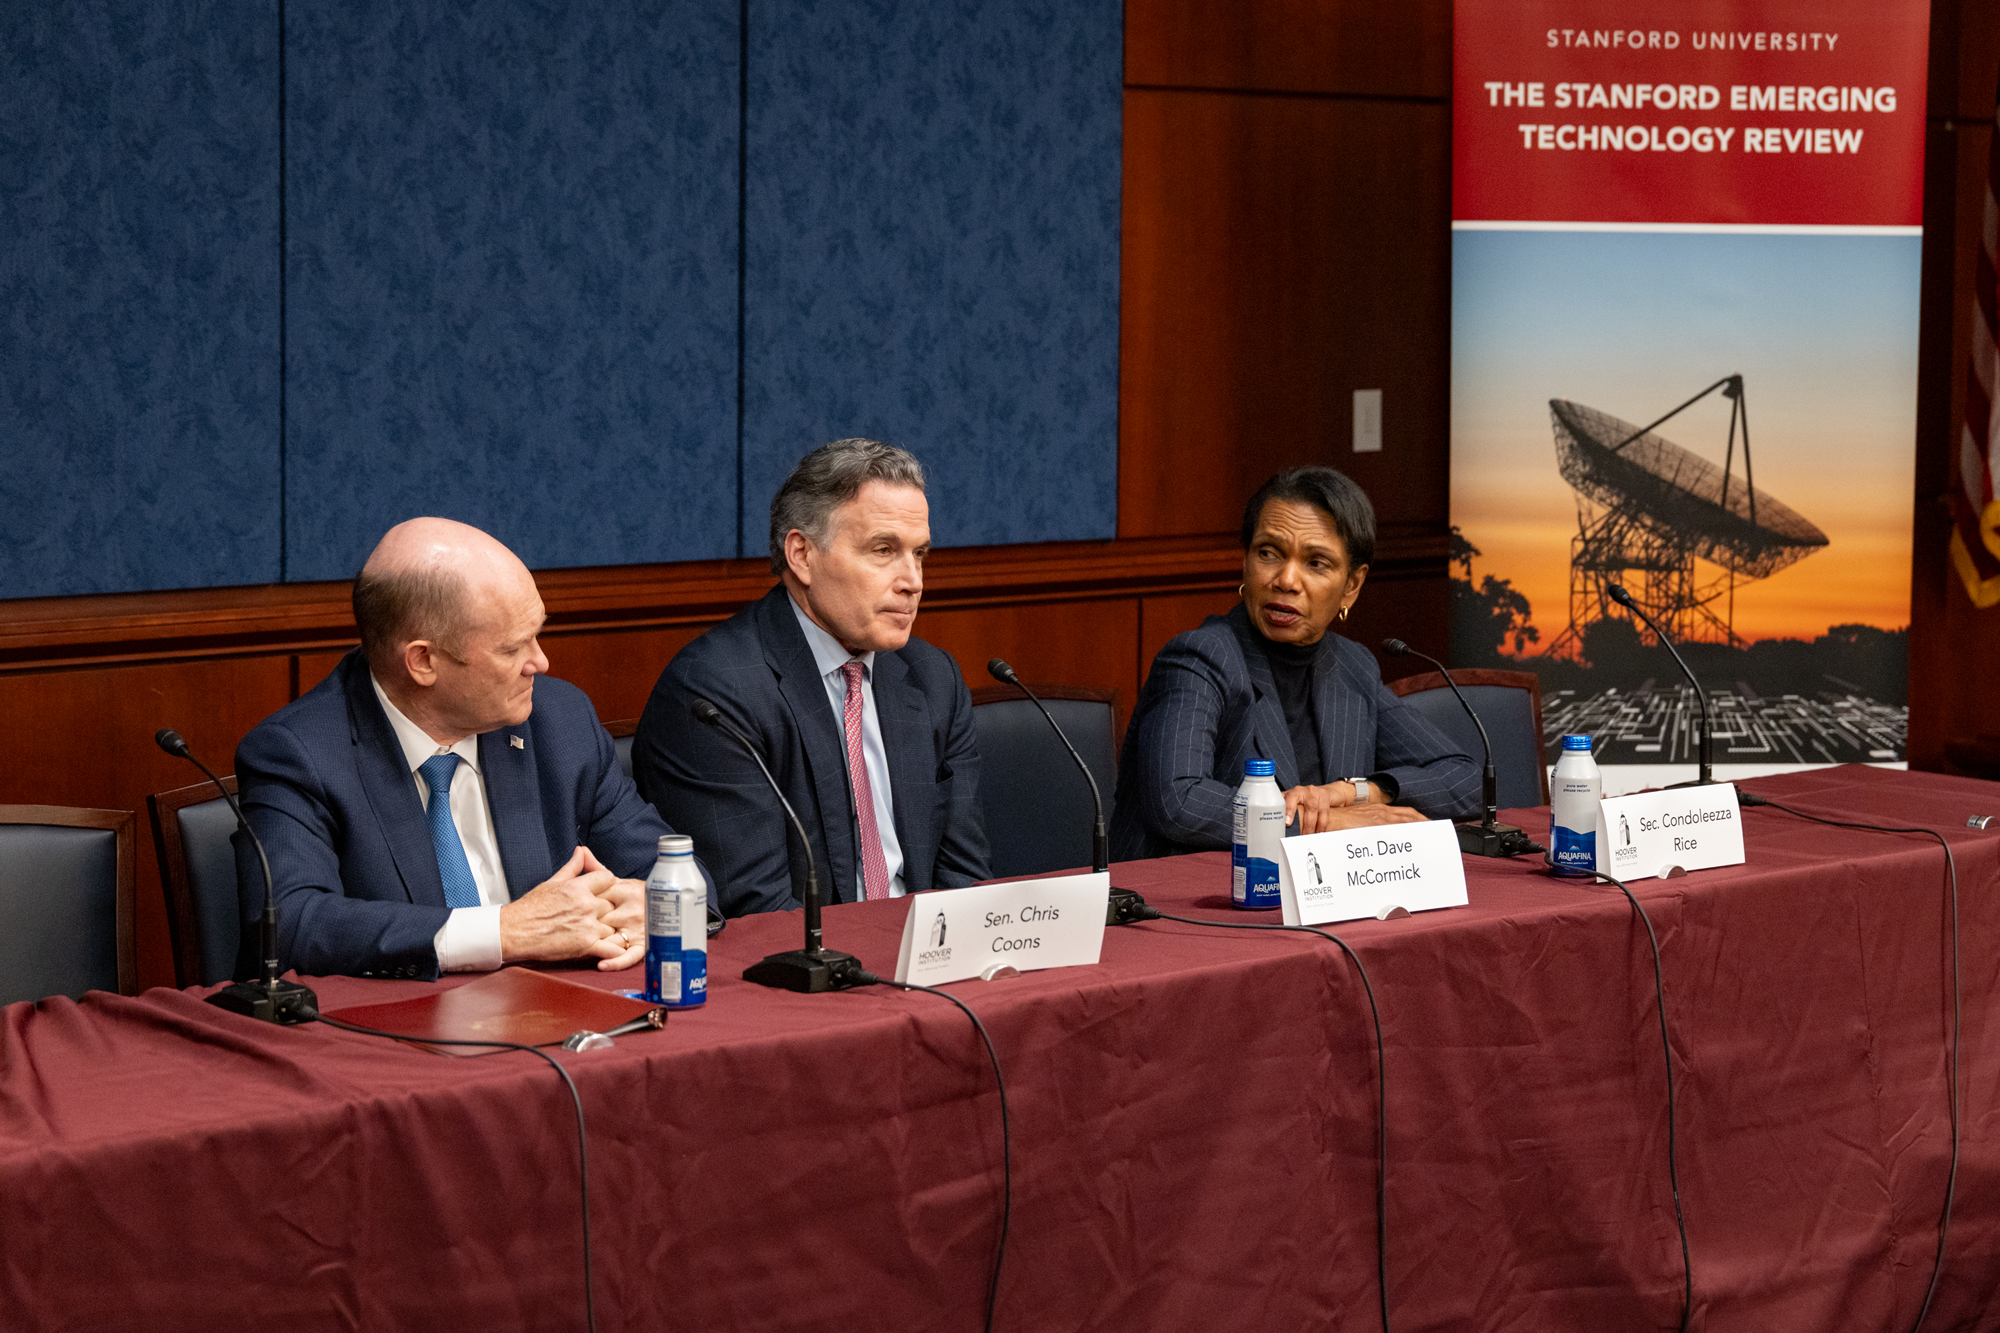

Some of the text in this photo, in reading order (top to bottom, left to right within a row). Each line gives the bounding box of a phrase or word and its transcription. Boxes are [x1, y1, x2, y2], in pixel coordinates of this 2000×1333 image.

[1547, 29, 1839, 51] STANFORD UNIVERSITY
[1484, 81, 1897, 113] THE STANFORD EMERGING
[1518, 124, 1864, 154] TECHNOLOGY REVIEW
[1639, 808, 1732, 832] Sec. Condoleezza
[1346, 840, 1413, 859] Sen. Dave
[1614, 846, 1638, 856] HOOVER
[1673, 836, 1698, 852] Rice
[1557, 851, 1593, 862] AQUAFINA
[1347, 862, 1421, 887] McCormick
[1303, 886, 1333, 896] HOOVER
[983, 905, 1060, 928] Sen. Chris
[918, 947, 952, 960] HOOVER
[991, 936, 1041, 953] Coons
